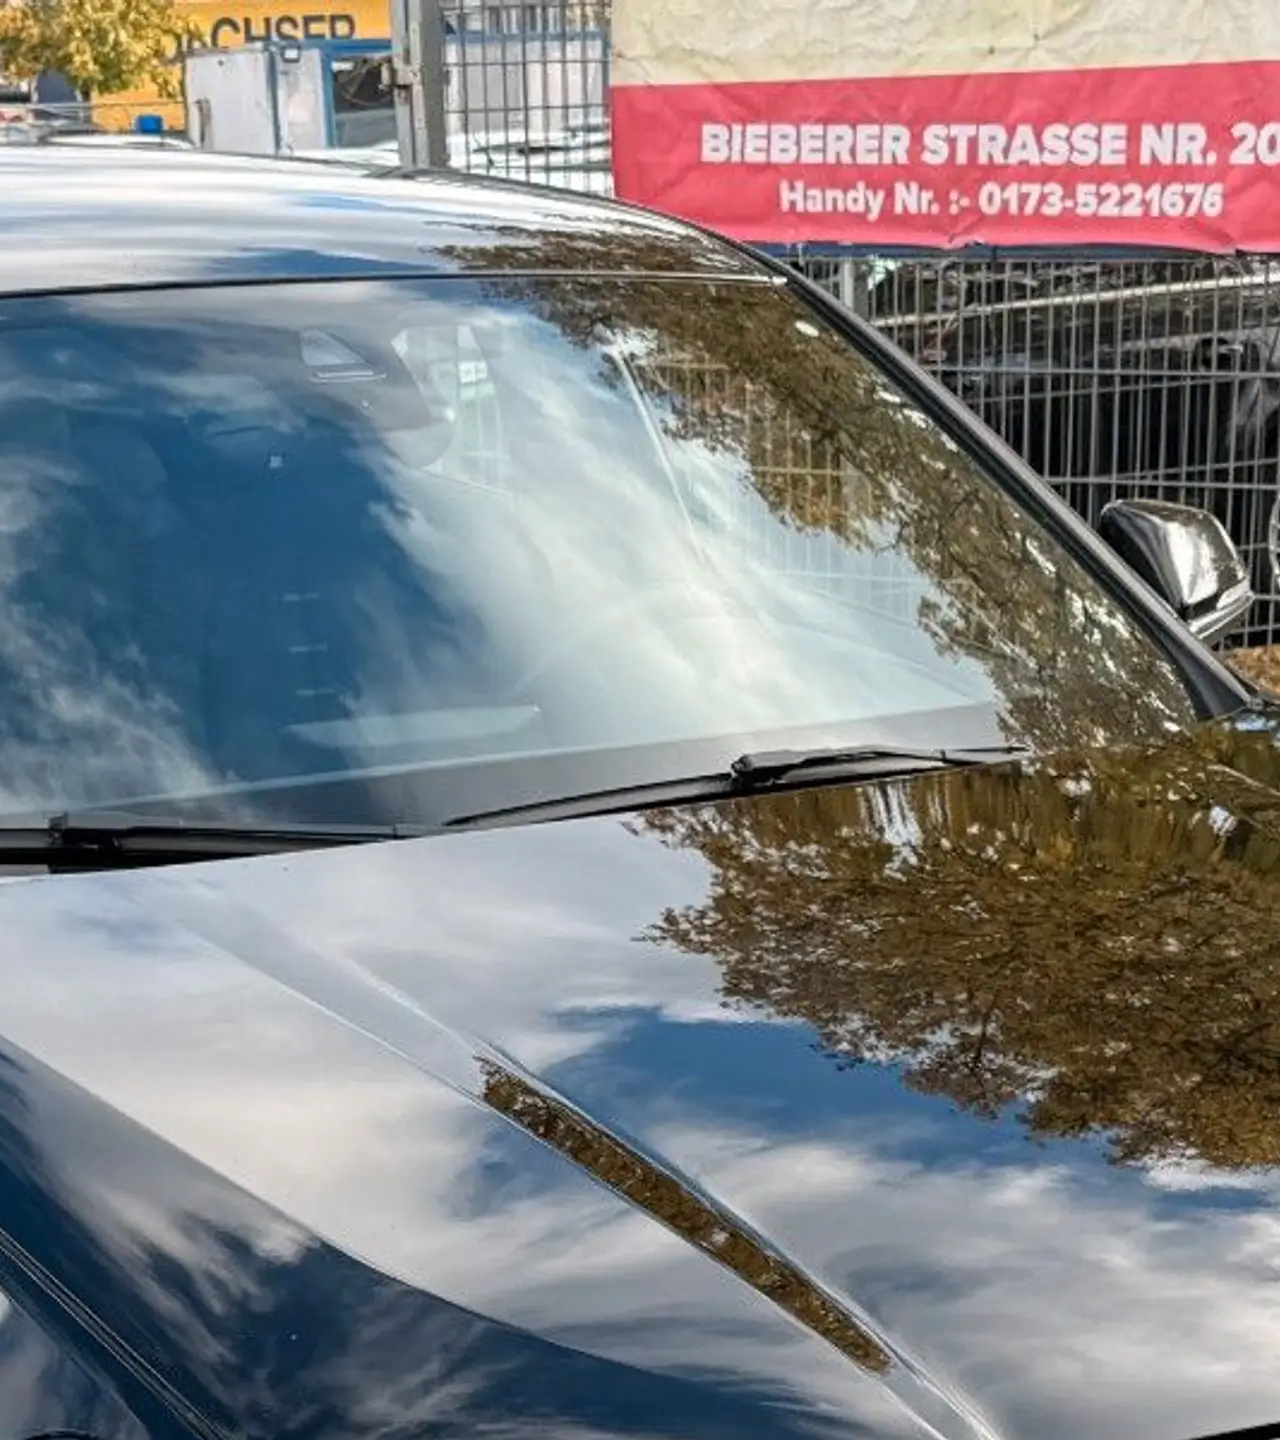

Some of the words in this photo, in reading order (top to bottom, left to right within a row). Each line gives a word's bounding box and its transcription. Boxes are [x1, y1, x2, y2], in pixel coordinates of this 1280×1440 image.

[700, 123, 911, 164] BIEBERER
[922, 123, 1128, 166] STRASSE
[1140, 122, 1218, 165] NR.
[779, 179, 884, 222] Handy
[894, 181, 939, 214] Nr.
[978, 181, 1224, 217] 0173-5221676
